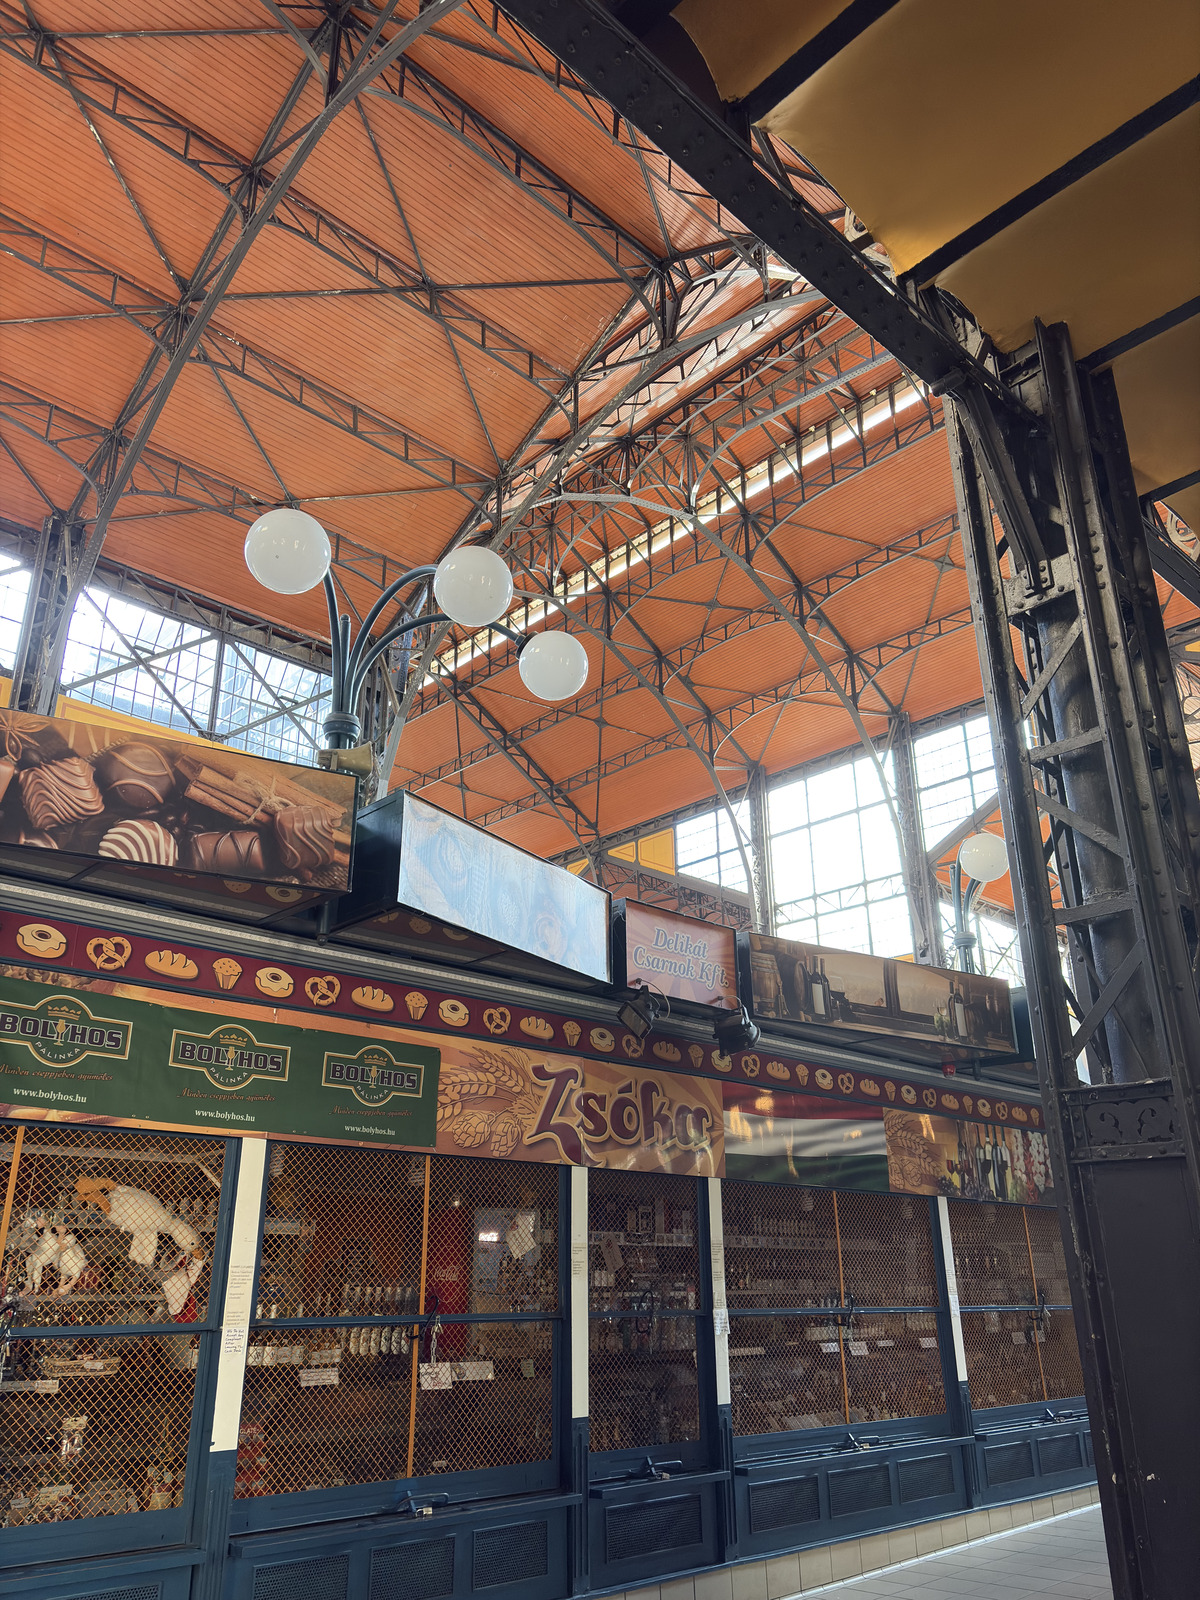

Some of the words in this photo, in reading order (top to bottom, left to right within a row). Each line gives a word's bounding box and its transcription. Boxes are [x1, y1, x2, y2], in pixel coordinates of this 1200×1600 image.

[652, 927, 709, 960] Delikát
[633, 945, 697, 980] Csarnok
[697, 960, 730, 991] Kft.
[0, 1012, 123, 1050] BOLYHOS
[35, 1041, 81, 1060] PÁLINKA
[178, 1041, 283, 1073] BOLYHOS
[209, 1067, 249, 1084] PÁLINKA
[329, 1061, 418, 1090] BOLYHOS
[13, 1088, 88, 1103] www.bolyhos.hu
[356, 1085, 389, 1101] PÁLINKA
[194, 1109, 256, 1122] www.bolyhos.hu
[523, 1063, 713, 1168] Zsóka
[344, 1124, 396, 1136] www.bolyhos.hu
